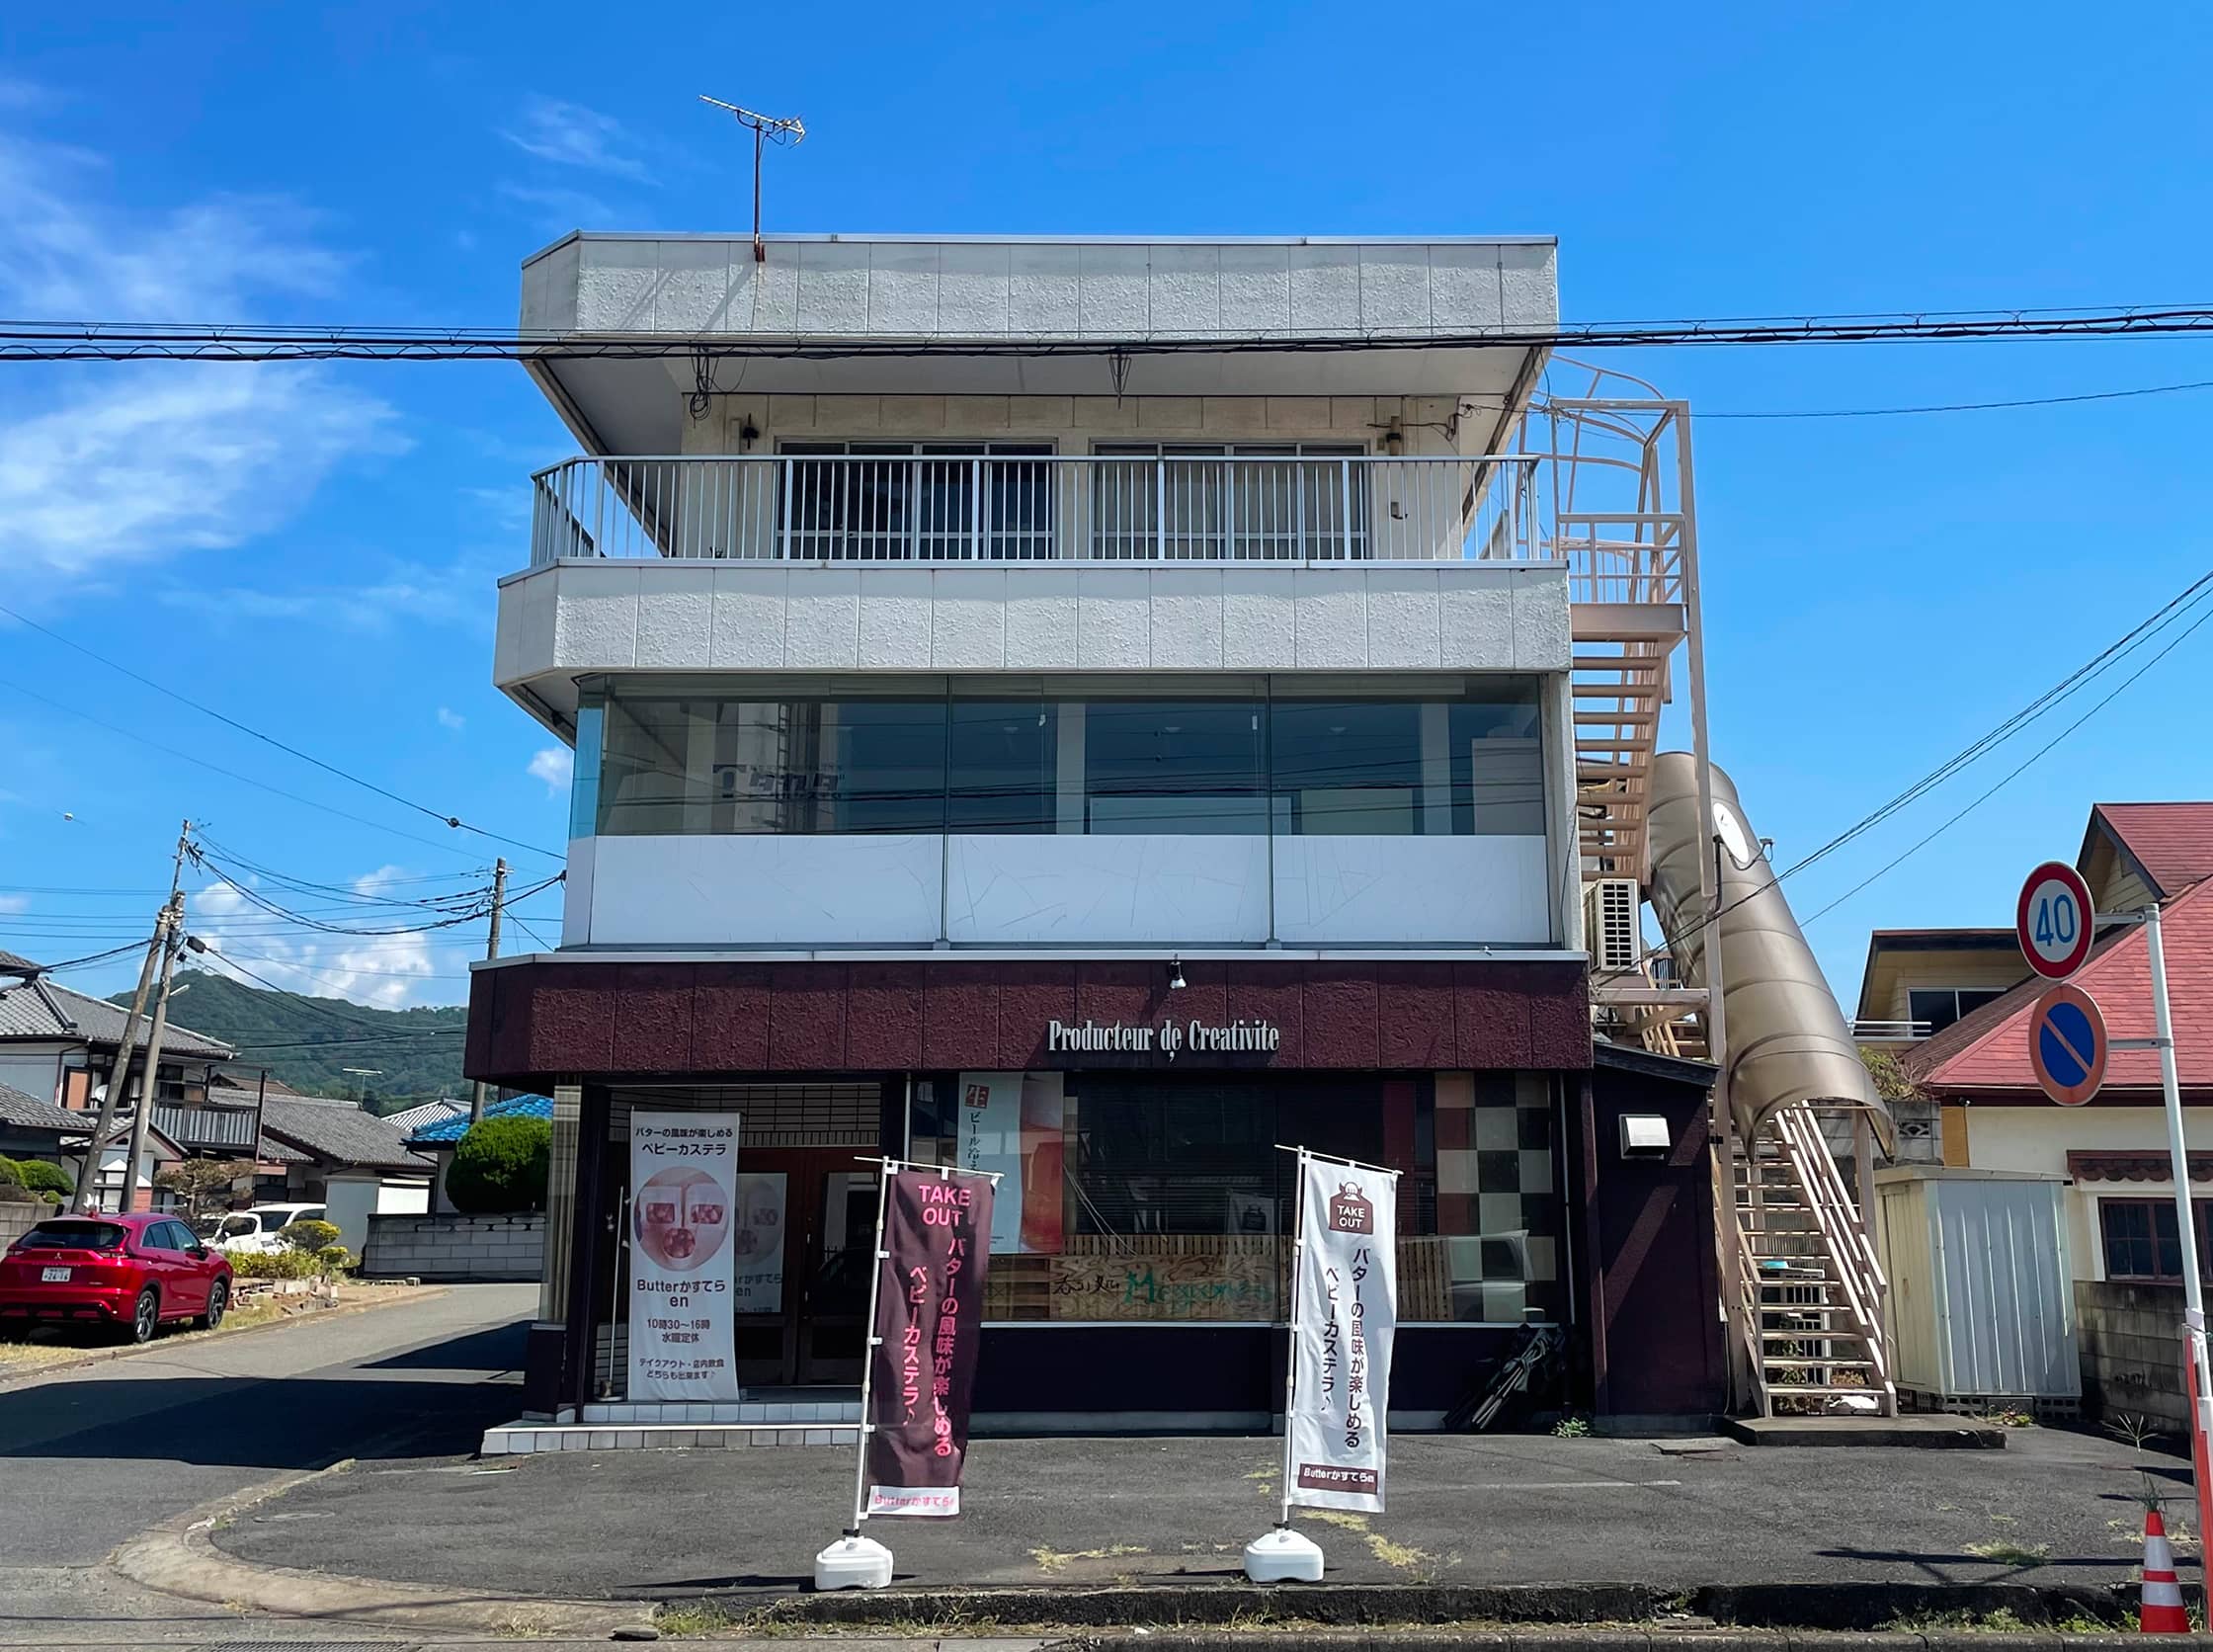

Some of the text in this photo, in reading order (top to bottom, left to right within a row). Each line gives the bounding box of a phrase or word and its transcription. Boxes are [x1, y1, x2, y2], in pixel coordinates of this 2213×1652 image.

[2036, 894, 2075, 947] 40
[1048, 1020, 1154, 1051] Producteur
[635, 1127, 733, 1138] バターの風味が楽しめる
[642, 1143, 726, 1156] ベビーカステラ
[919, 1185, 971, 1206] TAKE
[923, 1207, 963, 1227] OUT
[1337, 1204, 1365, 1218] TAKE
[1339, 1217, 1363, 1229] OUT
[637, 1279, 726, 1293] Butterかすてら
[670, 1295, 689, 1307] en
[933, 1238, 966, 1456] バターの風味が楽しめる
[1345, 1248, 1370, 1448] バターの風味が楽しめる
